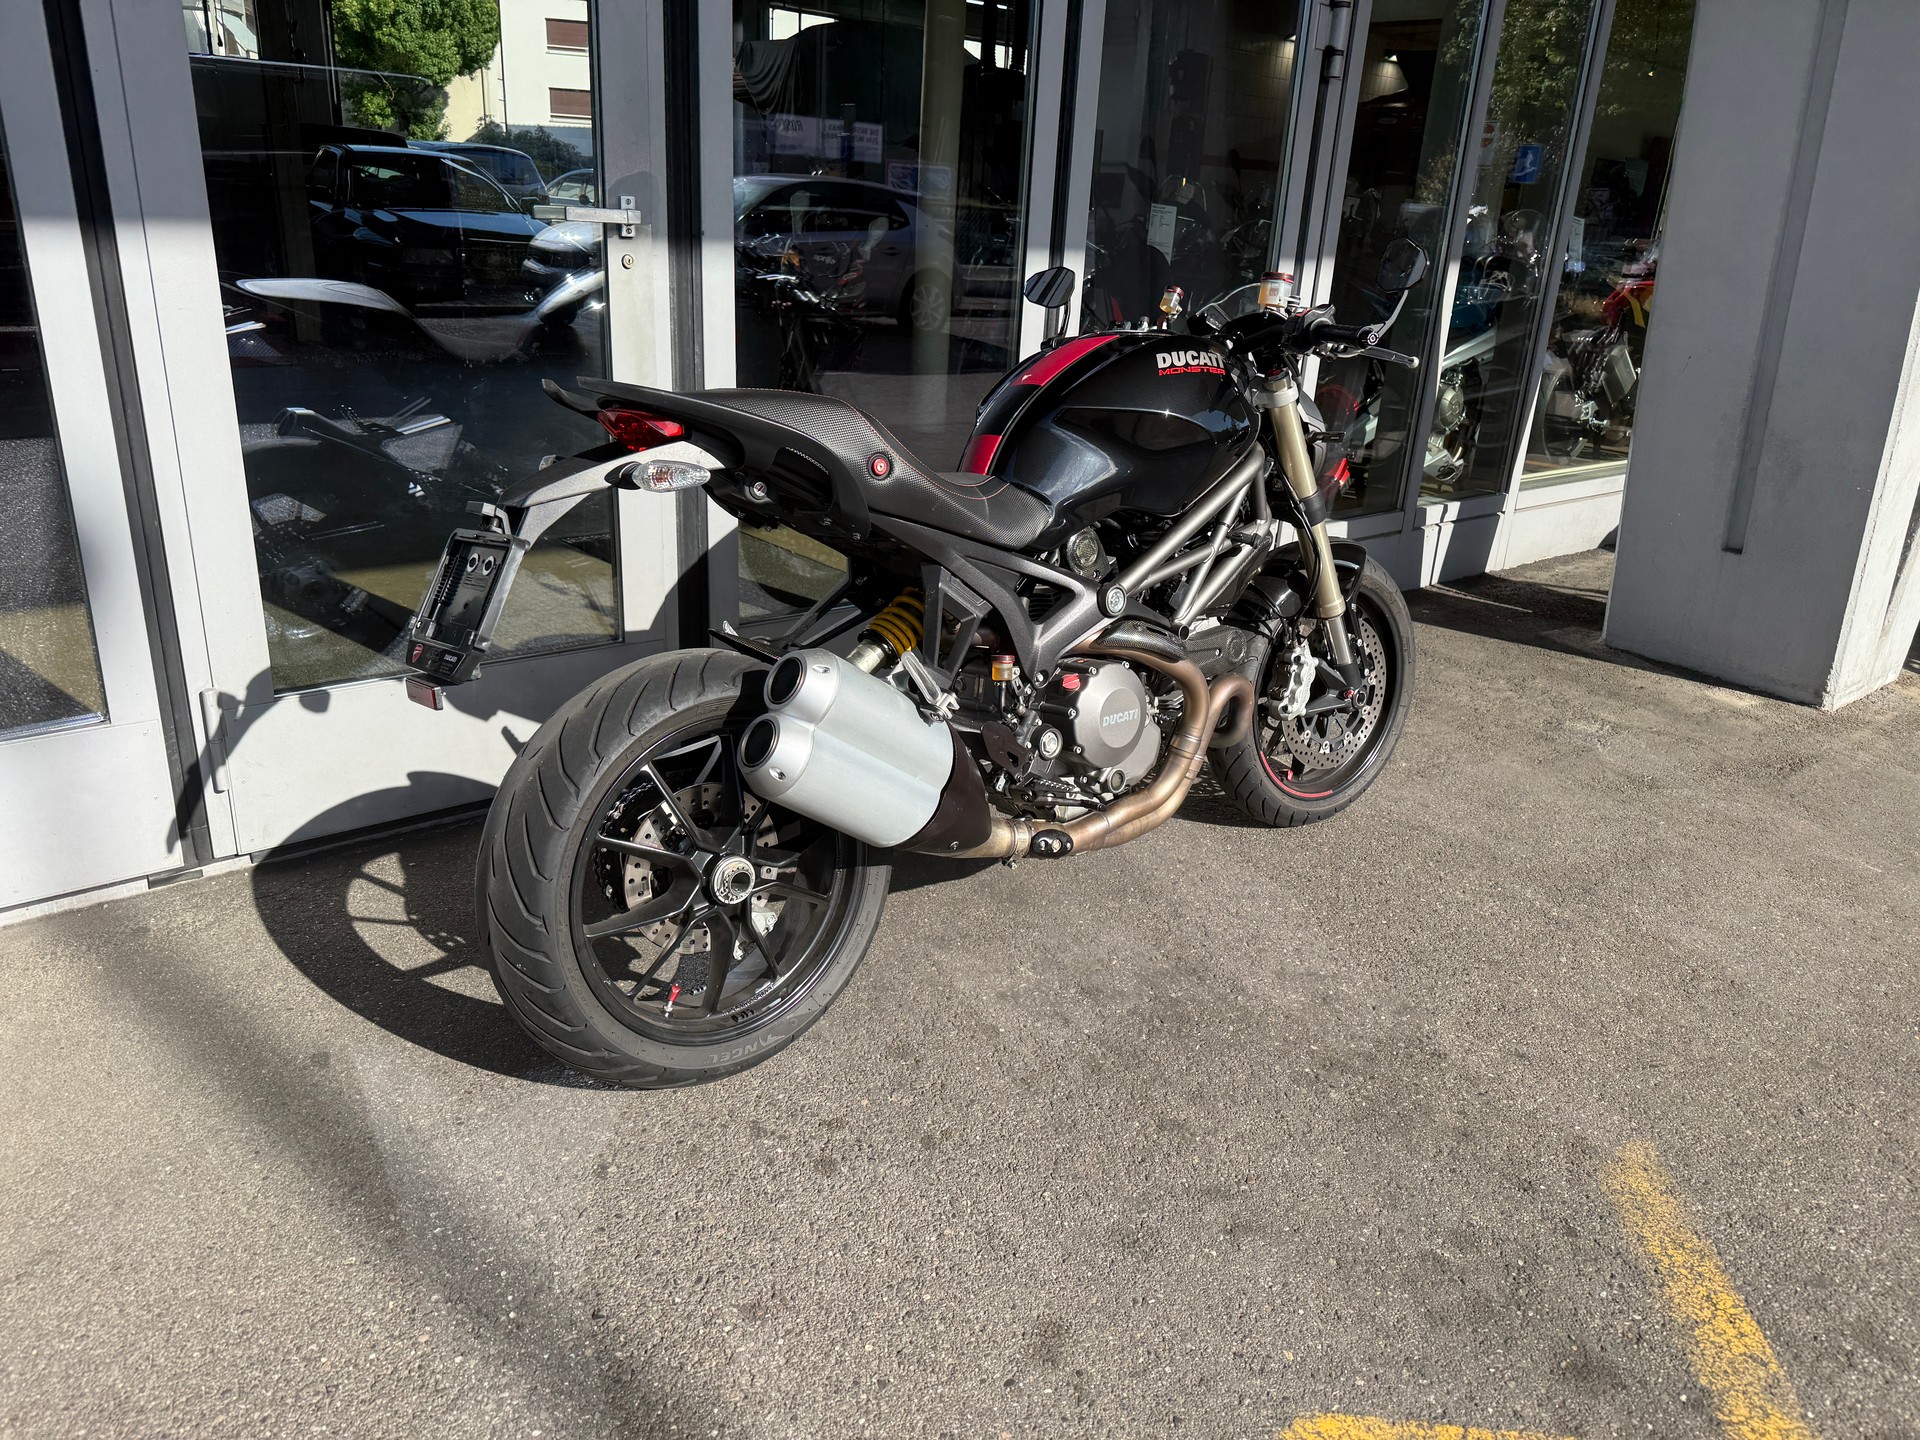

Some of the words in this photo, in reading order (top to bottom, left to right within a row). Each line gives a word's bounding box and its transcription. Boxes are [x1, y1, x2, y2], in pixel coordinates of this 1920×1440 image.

[1159, 367, 1226, 376] MONSTER
[443, 654, 458, 662] DUCATI
[1102, 709, 1138, 727] DUCATI
